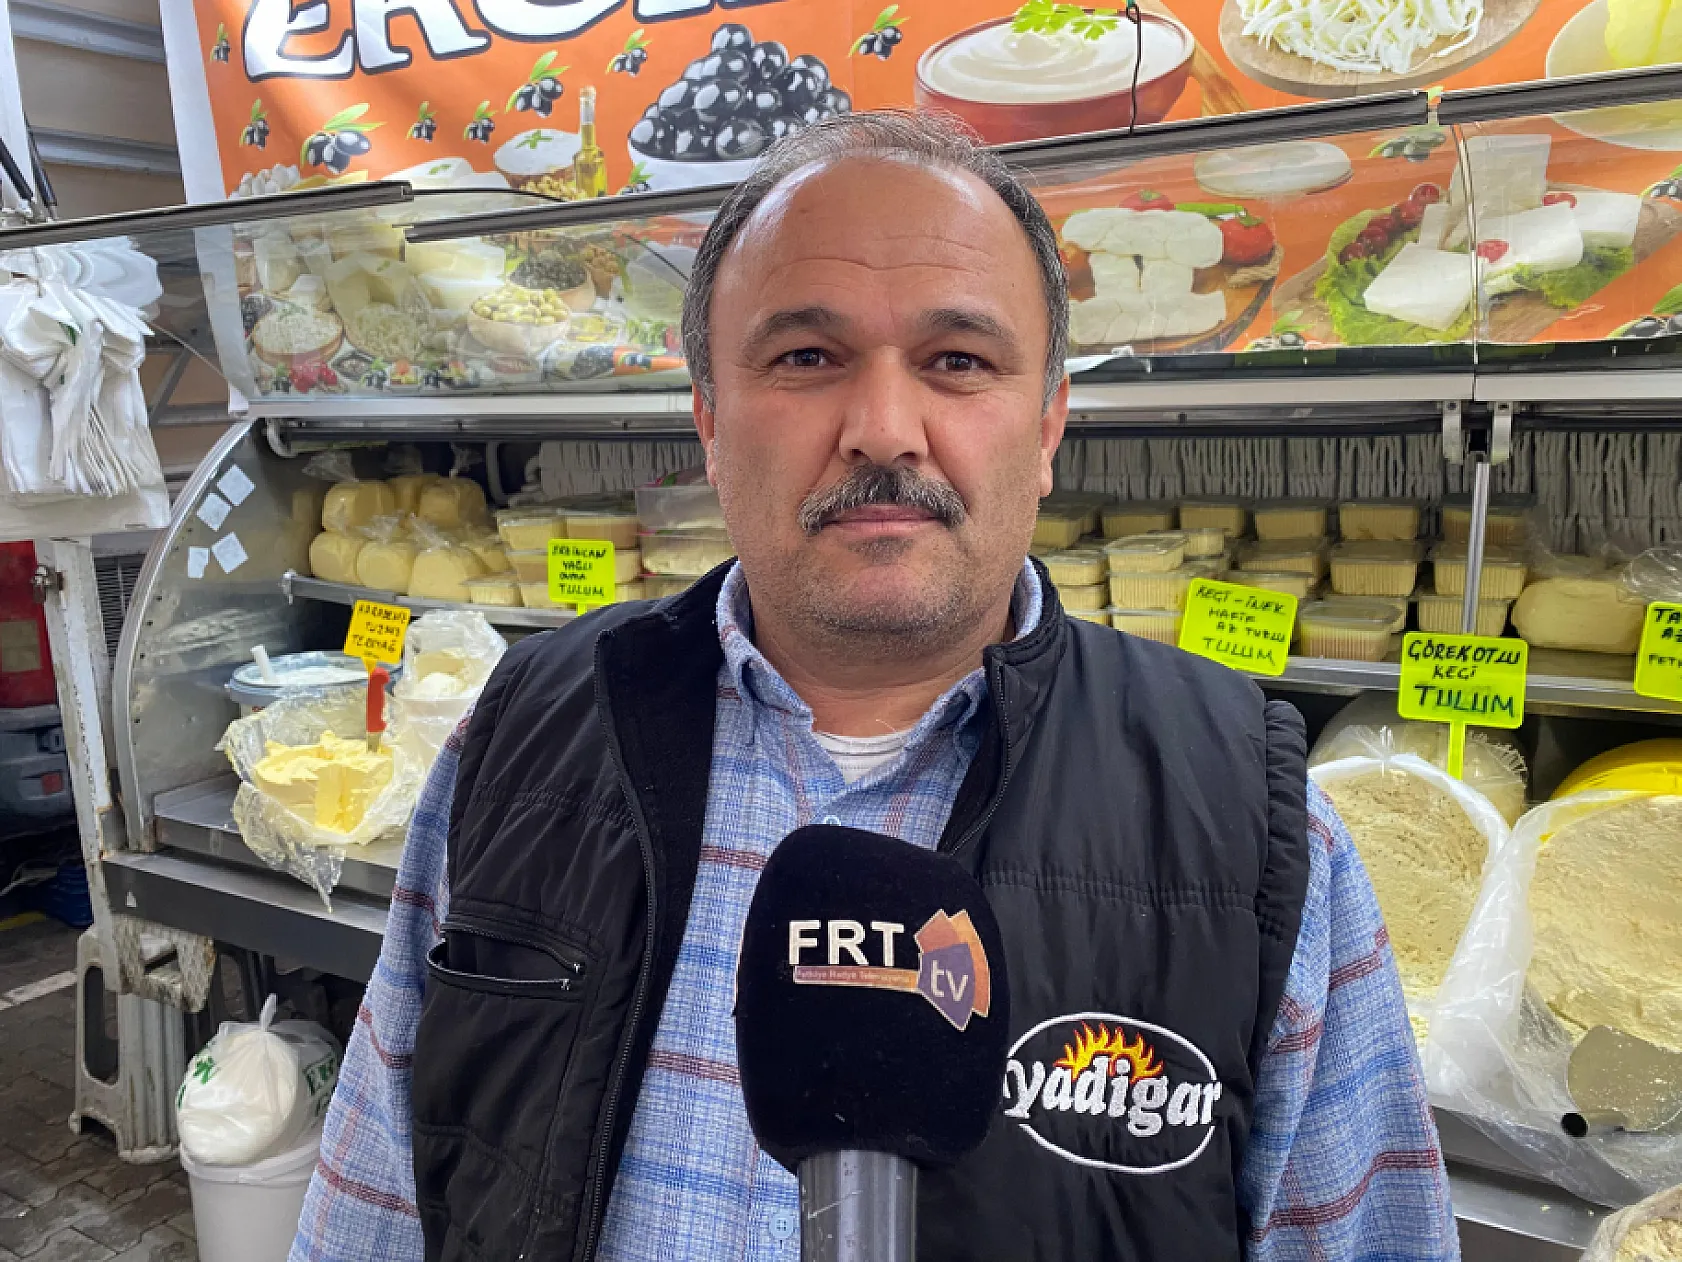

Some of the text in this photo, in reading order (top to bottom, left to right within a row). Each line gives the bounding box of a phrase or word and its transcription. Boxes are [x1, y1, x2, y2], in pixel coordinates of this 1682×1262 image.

[559, 583, 605, 598] TULUM
[1202, 637, 1275, 666] TULUM
[1413, 683, 1514, 718] TULUM
[788, 919, 905, 967] FRT
[930, 959, 968, 1002] tv
